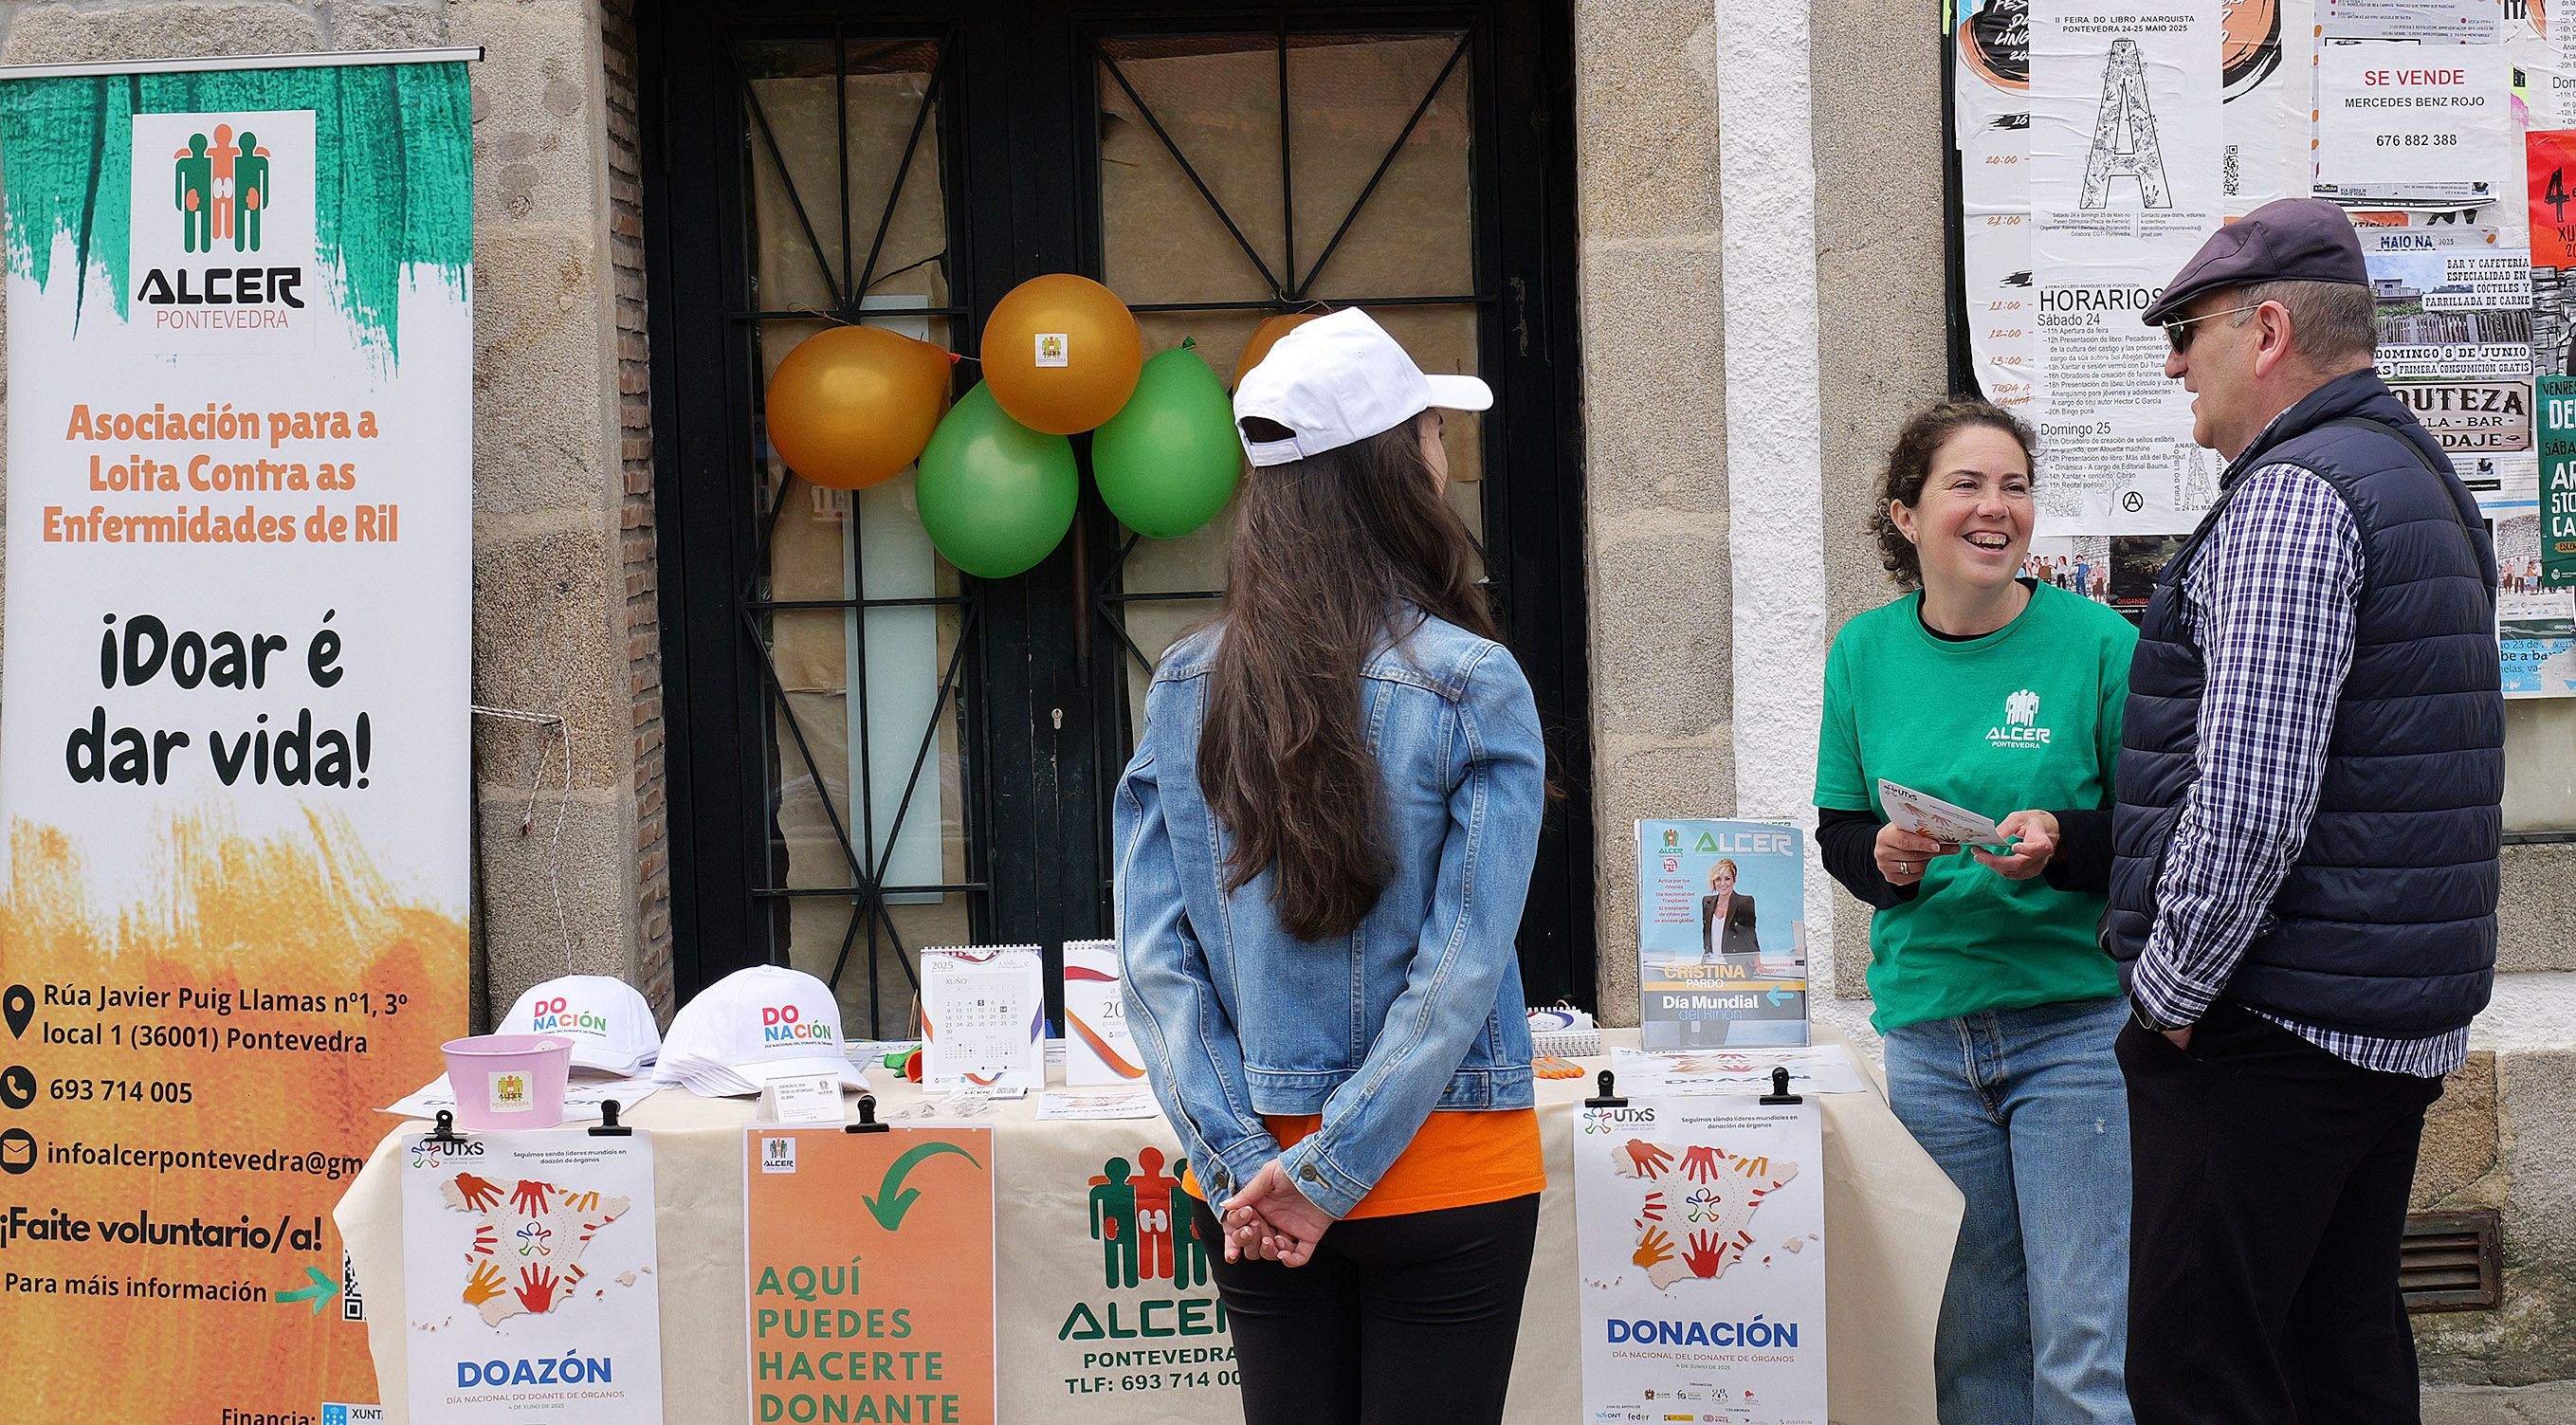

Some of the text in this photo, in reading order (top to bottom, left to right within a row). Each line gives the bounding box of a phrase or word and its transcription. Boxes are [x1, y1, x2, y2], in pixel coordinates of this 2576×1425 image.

[2065, 15, 2090, 24] FEIRA
[2141, 15, 2195, 24] ANARQUISTA
[2062, 25, 2120, 33] PONTEVEDRA
[2365, 70, 2465, 86] SE VENDE
[2346, 97, 2485, 108] MERCEDES BENZ ROJO
[2376, 135, 2457, 147] 676 882 388
[1985, 155, 2018, 165] 20:00
[1987, 216, 2020, 227] 21:00
[2381, 236, 2412, 249] MAIO
[2416, 236, 2433, 247] NA
[2447, 256, 2530, 269] BAR Y CAFETERÍA
[2447, 271, 2527, 282] ESPECIALIDAD EN
[137, 267, 304, 308] ALCER
[2476, 281, 2530, 294] CÓCTELES Y
[1988, 301, 2020, 311] 11:00
[2425, 296, 2530, 307] PARRILLADA DE CARNE
[156, 310, 288, 329] PONTEVEDRA
[2037, 313, 2101, 326] Sábado 24
[1988, 328, 2021, 339] 12:00
[1991, 356, 2021, 366] 13:00
[2375, 347, 2527, 359] DOMINGO 8 DE JUNIO
[2399, 360, 2530, 375] PRIMERA CONSUMICIÓN GRATIS
[66, 403, 378, 448] Asociación para a
[2040, 422, 2111, 438] Domingo 25
[2467, 417, 2503, 427] BAR
[89, 454, 356, 492] Loita Contra as
[43, 504, 398, 542] Enfermidades de Ril
[100, 609, 343, 690] ¡Doar é
[1985, 726, 2051, 743] ALCER
[65, 705, 371, 790] dar vida!
[1694, 831, 1793, 857] ALCER
[932, 961, 953, 970] 2025
[1663, 963, 1746, 978] CRISTINA
[945, 977, 968, 985] XUÑO
[1686, 979, 1725, 989] PARDO
[44, 984, 91, 1007] Rúa
[98, 985, 171, 1013] Javier
[178, 987, 231, 1014] Puig
[238, 988, 326, 1014] Llamas
[384, 993, 408, 1015] 3º
[535, 997, 566, 1017] DO
[1663, 995, 1759, 1009] Día Mundial
[534, 1011, 606, 1032] NACIÓN
[762, 1005, 798, 1026] DO
[44, 1022, 368, 1053] local 1 (36001) Pontevedra
[764, 1020, 831, 1041] NACIÓN
[50, 1079, 192, 1104] 693 714 005
[1614, 1108, 1655, 1122] UTxS
[443, 1140, 484, 1156] UTxS
[514, 1151, 544, 1160] Seguimos
[47, 1142, 363, 1179] infoalcerpontevedra@gm
[574, 1156, 599, 1164] órganos
[0, 1206, 321, 1254] ¡Faite voluntario/a!
[756, 1256, 861, 1302] AQUÍ
[6, 1272, 267, 1303] Para máis información
[758, 1308, 912, 1339] PUEDES
[1058, 1299, 1227, 1341] ALCE
[1607, 1314, 1798, 1348] DONACIÓN
[1084, 1347, 1237, 1368] PONTEVEDRA
[1612, 1350, 1628, 1359] DÍA
[1630, 1352, 1673, 1361] NACIONAL
[1693, 1354, 1735, 1362] DONANTE
[1751, 1354, 1795, 1362] ÓRGANOS
[457, 1348, 612, 1388] DOAZÓN
[758, 1351, 943, 1380] HACERTE
[1065, 1378, 1113, 1394] TLF:
[1122, 1375, 1161, 1390] 693
[1170, 1372, 1210, 1388] 714
[447, 1396, 463, 1404] DÍA
[465, 1395, 510, 1404] NACIONAL
[529, 1392, 564, 1400] DOANTE
[581, 1390, 625, 1398] ÓRGANOS
[222, 1408, 383, 1425] Financia: XUNT
[760, 1394, 959, 1425] DONANTE
[1627, 1413, 1650, 1421] feder
